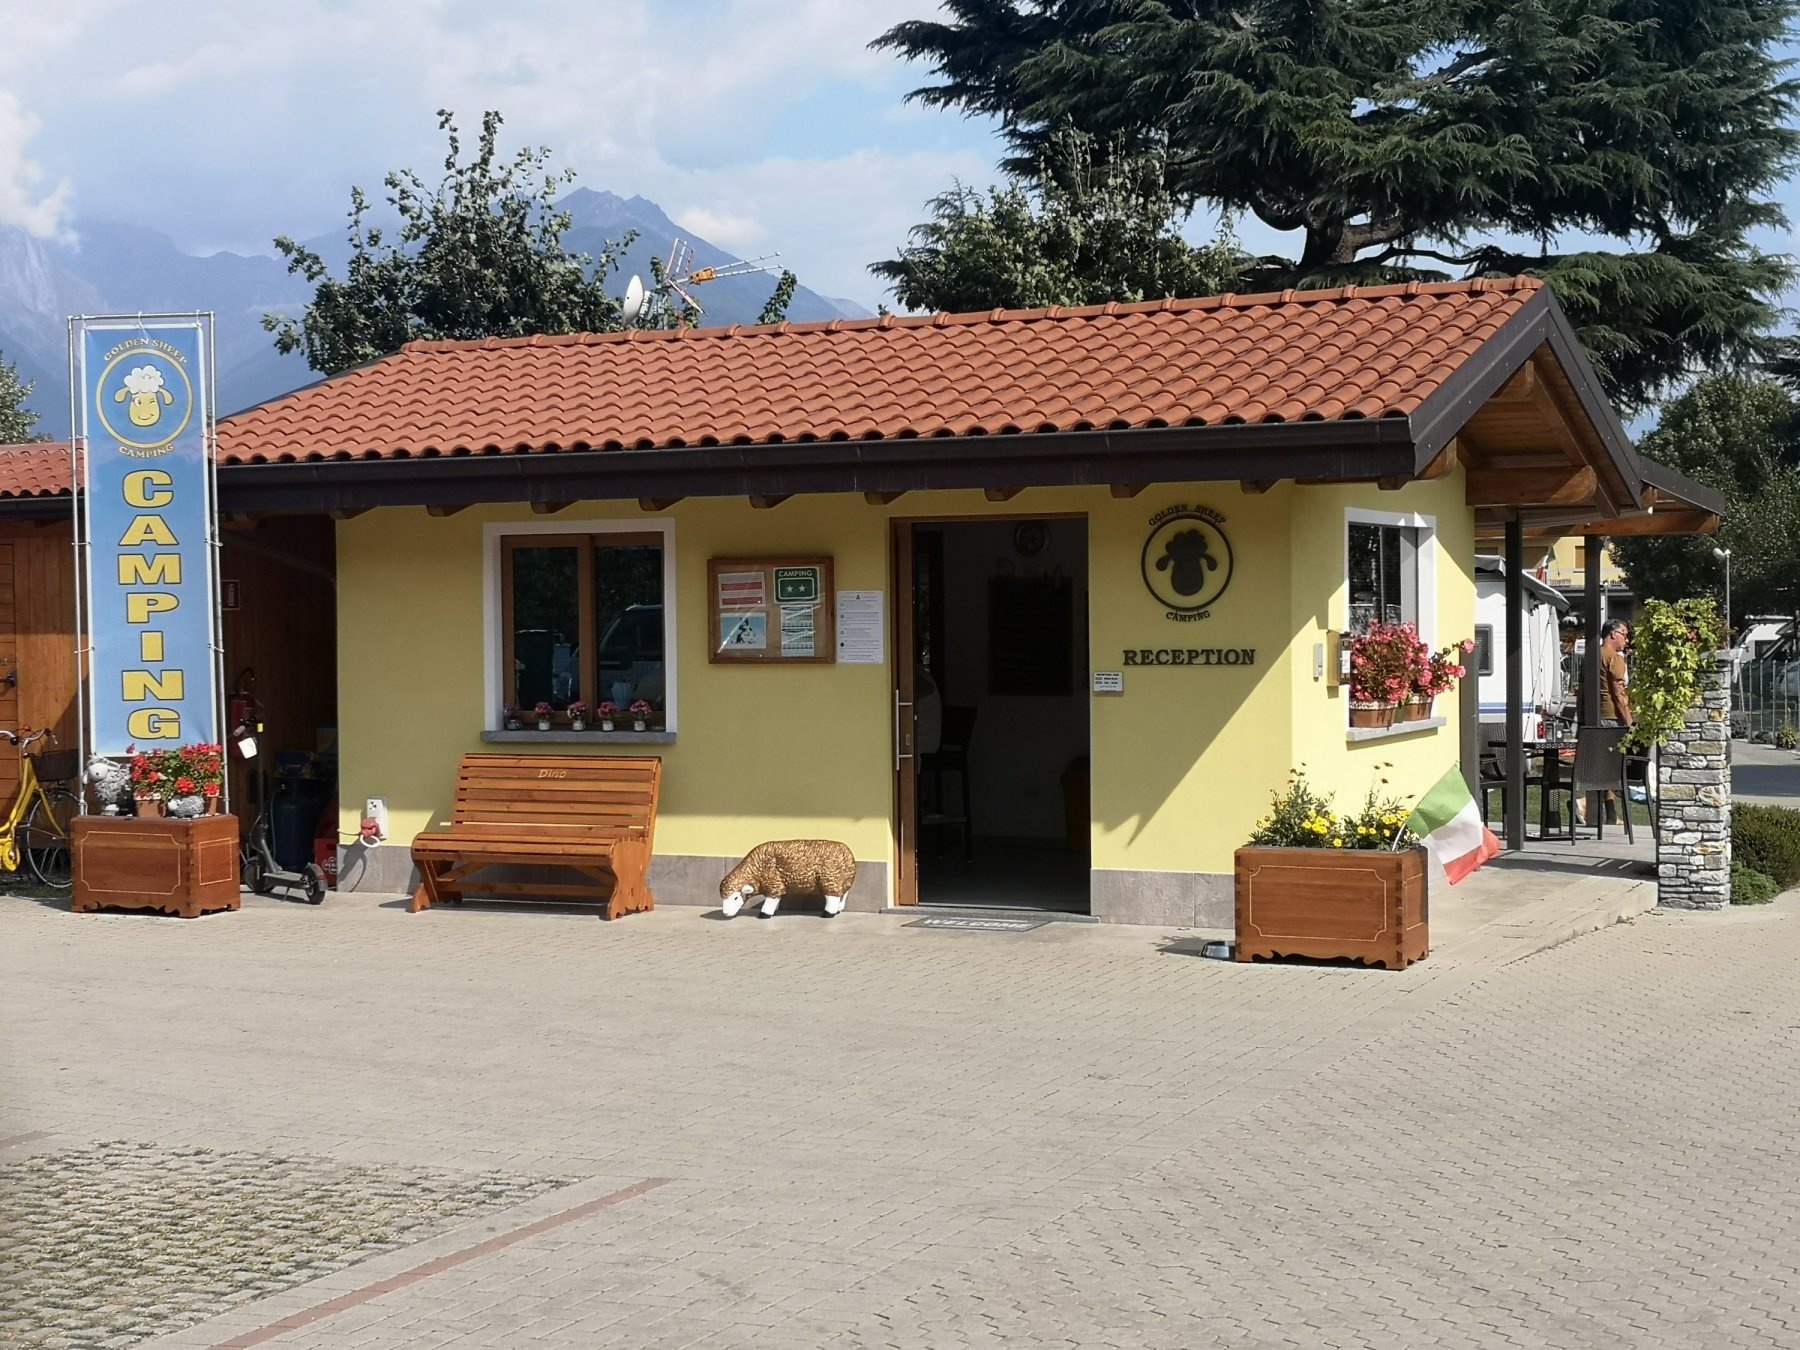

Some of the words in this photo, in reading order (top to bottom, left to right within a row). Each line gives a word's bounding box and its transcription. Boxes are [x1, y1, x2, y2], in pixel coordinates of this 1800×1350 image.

[104, 338, 149, 361] GOLDEN
[151, 339, 188, 364] SHEEP
[118, 443, 174, 458] CAMPING
[1148, 504, 1187, 527] GOLDEN
[1195, 504, 1226, 524] SHEEP
[778, 569, 813, 577] CAMPING
[117, 469, 185, 740] CAMPING
[1166, 610, 1211, 622] CAMPING
[1123, 648, 1255, 666] RECEPTION
[538, 769, 567, 778] Dino
[924, 919, 1031, 929] WELCOME
